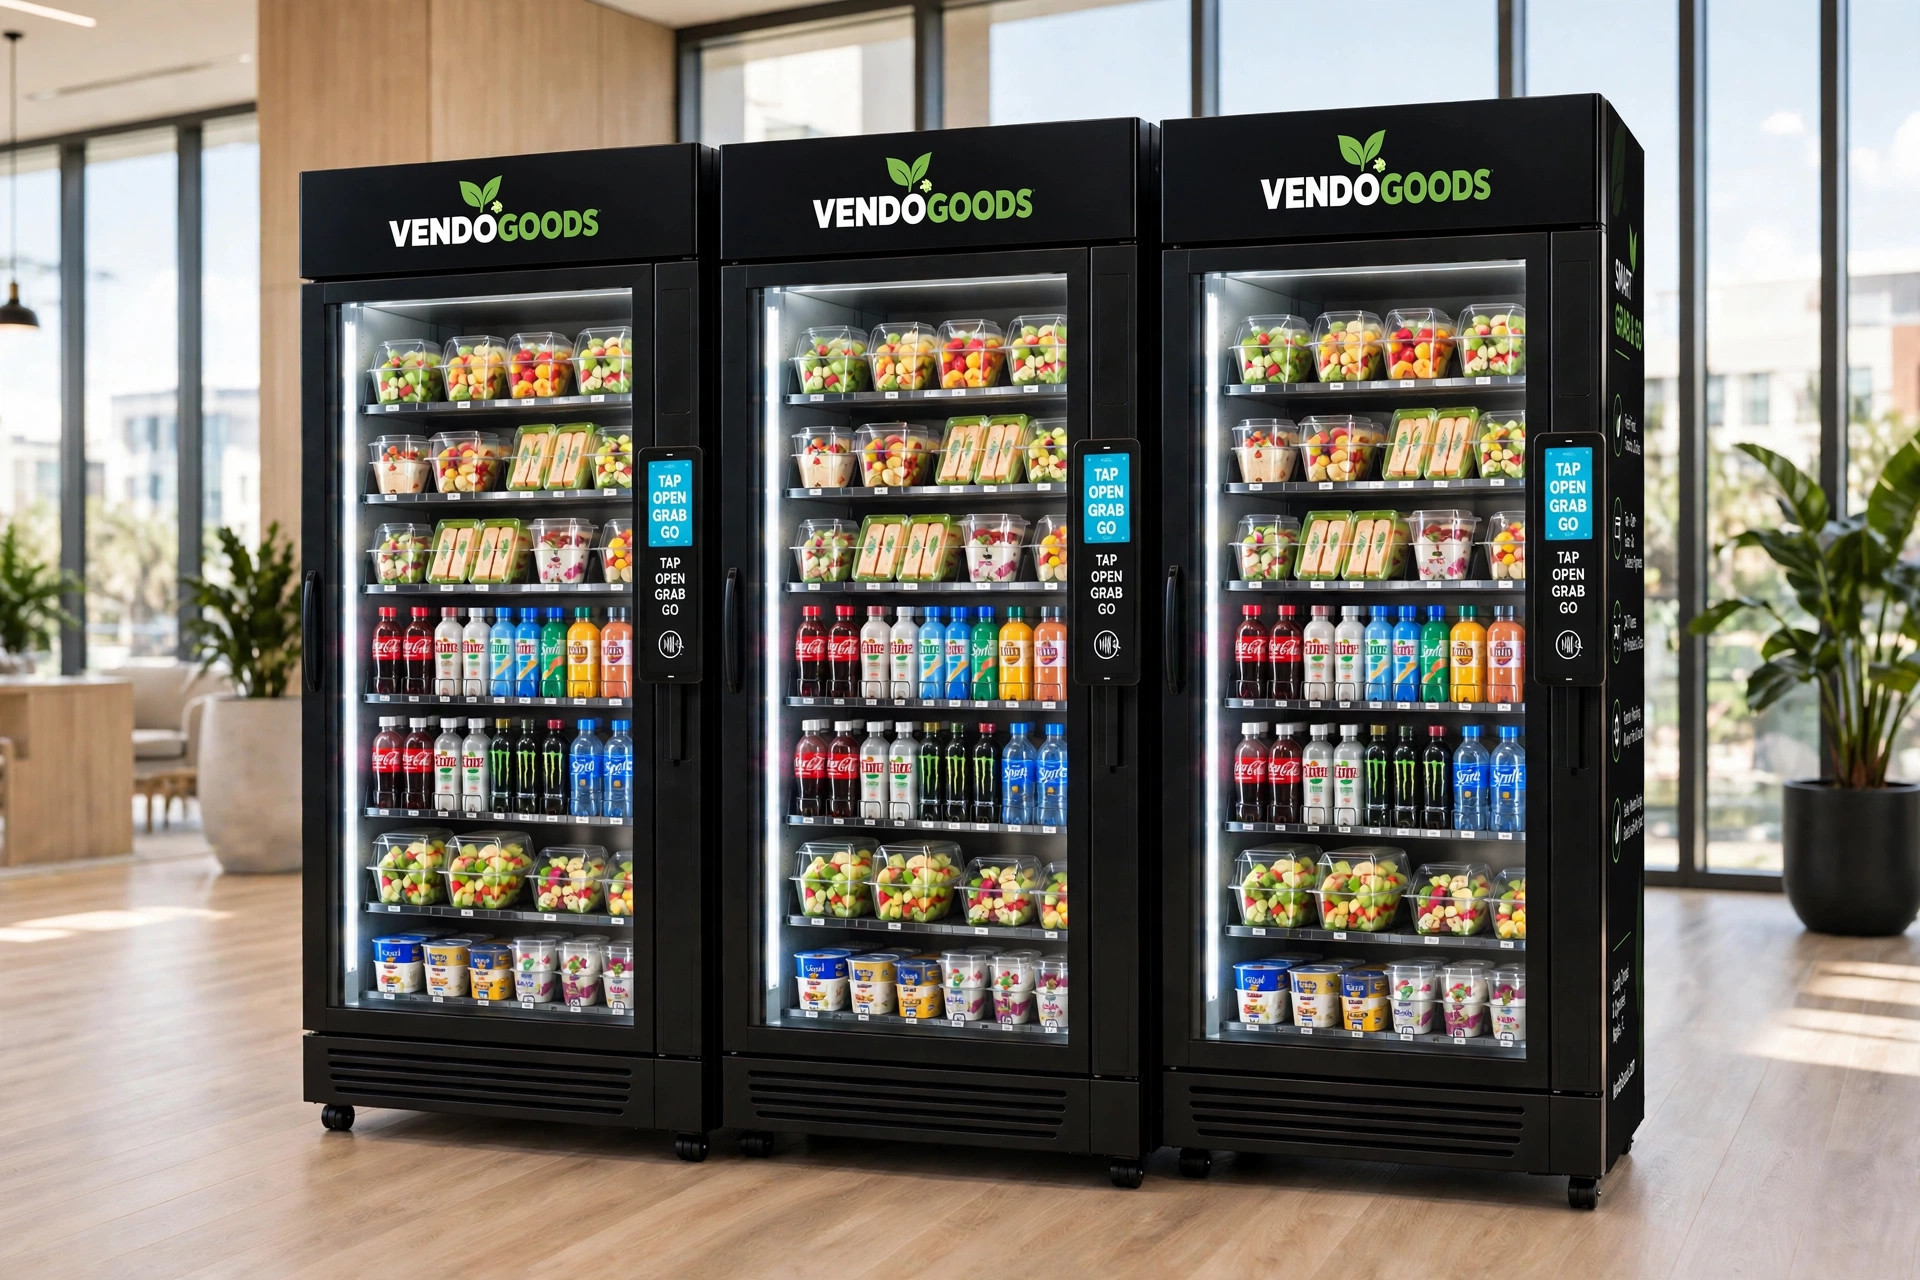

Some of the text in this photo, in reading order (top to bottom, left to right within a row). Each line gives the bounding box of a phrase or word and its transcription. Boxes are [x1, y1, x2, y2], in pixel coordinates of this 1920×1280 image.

[1260, 168, 1492, 210] VENDOGOODS
[812, 188, 1034, 229] VENDOGOODS
[388, 208, 600, 248] VENDOGOODS
[1093, 466, 1119, 481] TAP
[1555, 461, 1581, 477] TAP
[658, 474, 682, 488] TAP
[1549, 479, 1586, 495] OPEN
[652, 490, 687, 505] OPEN
[1088, 484, 1124, 499] OPEN
[1087, 503, 1125, 517] GRAB
[1549, 498, 1587, 513] GRAB
[652, 508, 688, 522] GRAB
[1096, 520, 1117, 535] GO
[1558, 516, 1579, 532] GO
[660, 525, 680, 539] GO
[659, 556, 681, 569] TAP
[1095, 553, 1118, 567] TAP
[1556, 550, 1580, 564] TAP
[654, 572, 686, 585] OPEN
[1090, 569, 1123, 583] OPEN
[1552, 567, 1585, 581] OPEN
[654, 587, 686, 601] GRAB
[1090, 586, 1123, 600] GRAB
[1551, 584, 1586, 598] GRAB
[661, 603, 679, 616] GO
[1097, 602, 1116, 615] GO
[1559, 601, 1578, 614] GO
